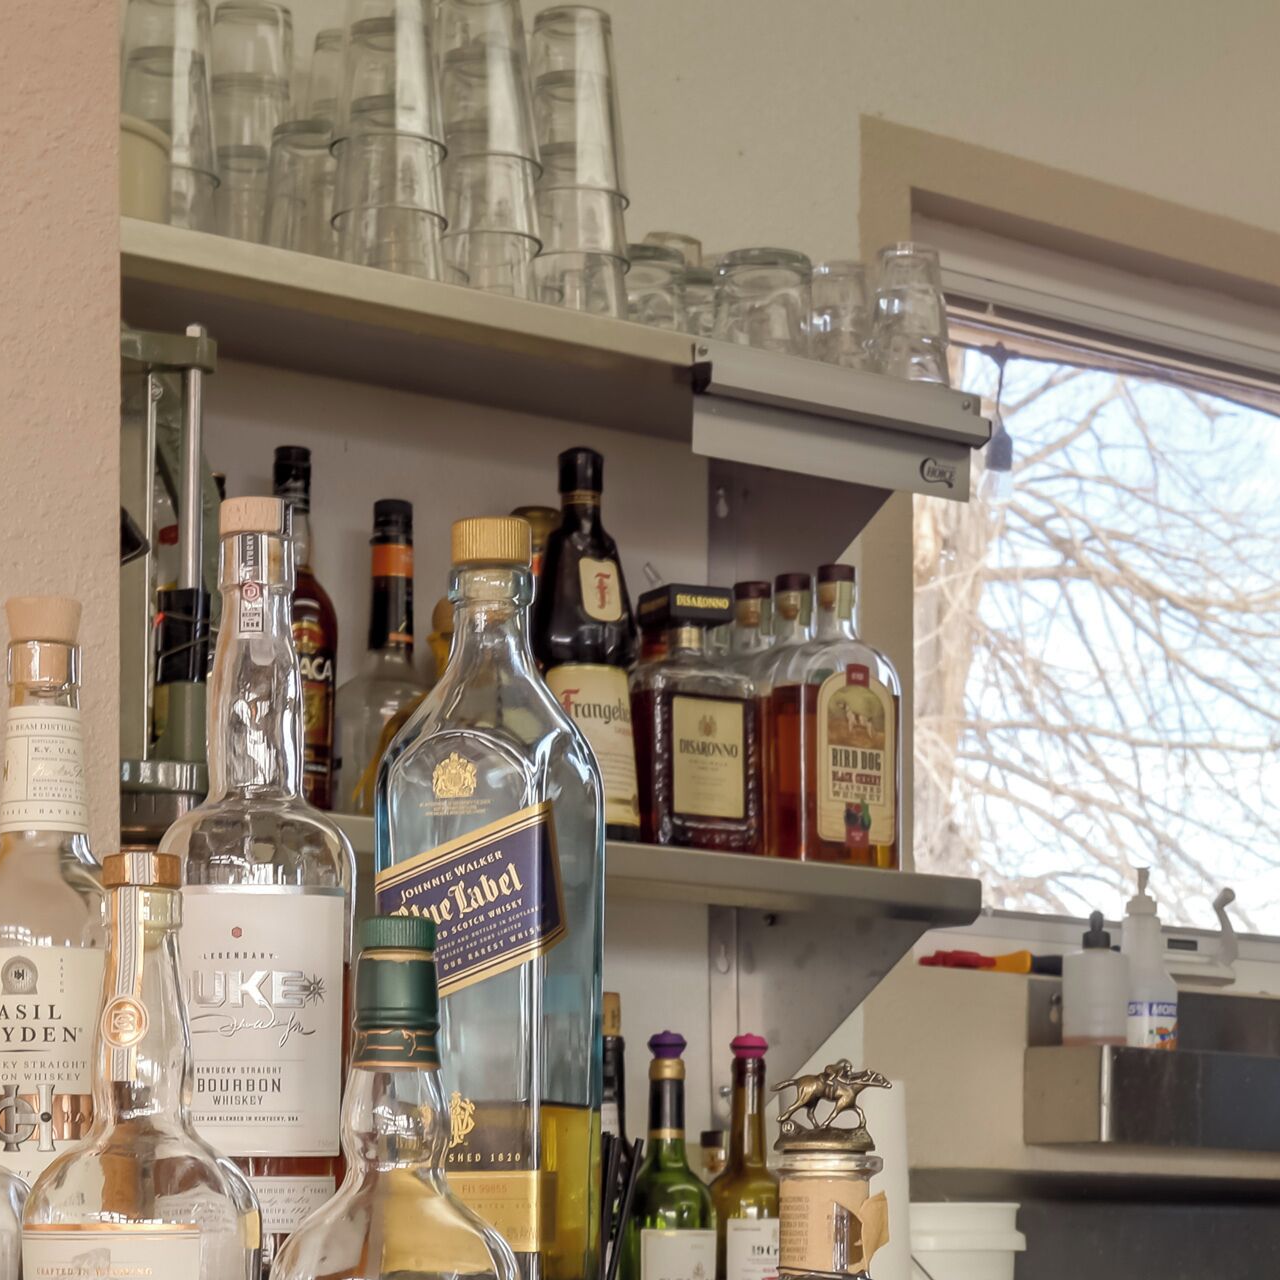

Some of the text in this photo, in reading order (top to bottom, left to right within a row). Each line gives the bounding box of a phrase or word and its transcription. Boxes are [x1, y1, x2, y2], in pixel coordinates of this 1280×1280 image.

[675, 593, 730, 610] DISARONNO
[300, 656, 333, 681] ACA
[678, 738, 740, 759] DISARONNO
[831, 748, 882, 772] BIRD DOG
[831, 770, 854, 784] BLACK
[400, 850, 503, 904] JOHNNIE WALKER
[447, 862, 524, 919] Label
[451, 898, 523, 934] SCOTCH WHISKY
[203, 952, 274, 960] LEGENDARY
[443, 939, 504, 971] OUR RAREST
[188, 969, 307, 1009] UKE
[23, 1060, 88, 1069] STRAIGHT
[196, 1066, 283, 1074] KENTUCKY STRAIGHT
[23, 1073, 82, 1081] WHISKEY
[197, 1078, 282, 1093] BOURBON
[212, 1095, 264, 1106] WHISKEY
[490, 1152, 521, 1162] 1820
